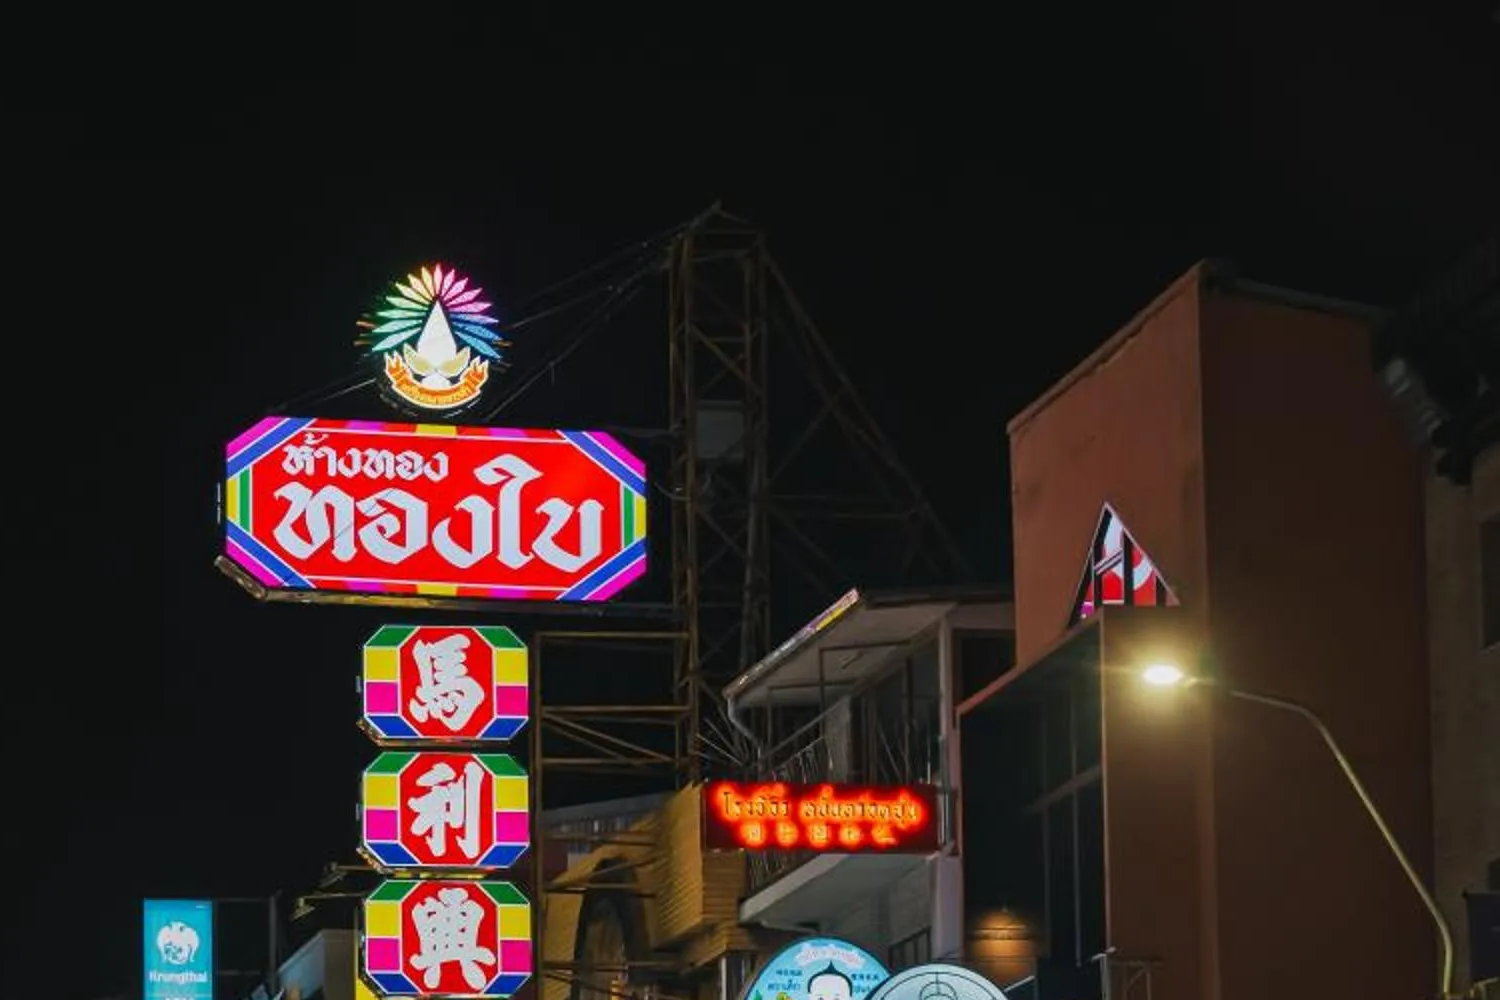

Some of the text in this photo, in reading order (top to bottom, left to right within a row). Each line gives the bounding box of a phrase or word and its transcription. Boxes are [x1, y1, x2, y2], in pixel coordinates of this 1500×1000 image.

[281, 432, 449, 480] ห้างทอง
[273, 453, 605, 574] ทองใบ
